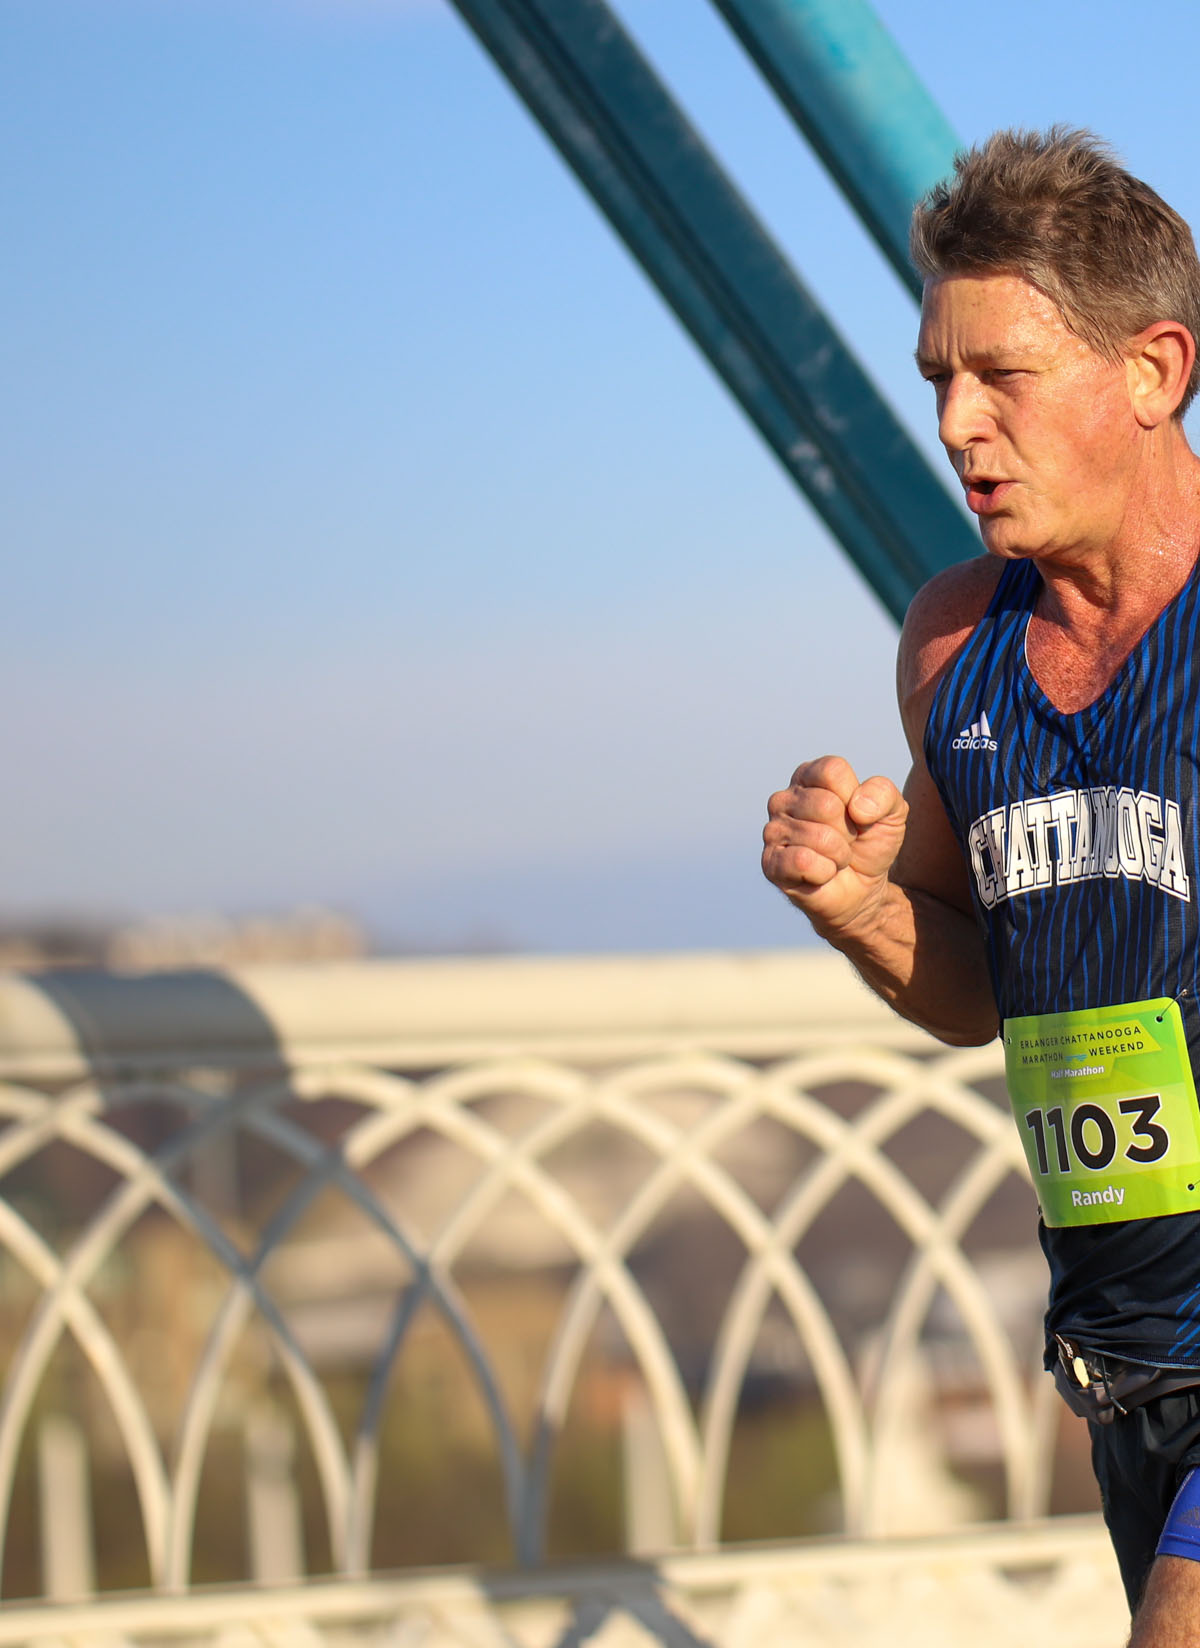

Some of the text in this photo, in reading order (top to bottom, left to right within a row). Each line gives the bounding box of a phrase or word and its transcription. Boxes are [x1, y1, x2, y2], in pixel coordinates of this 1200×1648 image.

[952, 736, 998, 751] adidas
[968, 785, 1191, 911] CHATTANOOGA
[1020, 1026, 1142, 1049] ERLANGER CHATTANOOGA
[1022, 1041, 1145, 1064] MARATHON WEEKEND
[1064, 1065, 1105, 1078] Marathon
[1025, 1093, 1171, 1175] 1103
[1071, 1185, 1126, 1207] Randy
